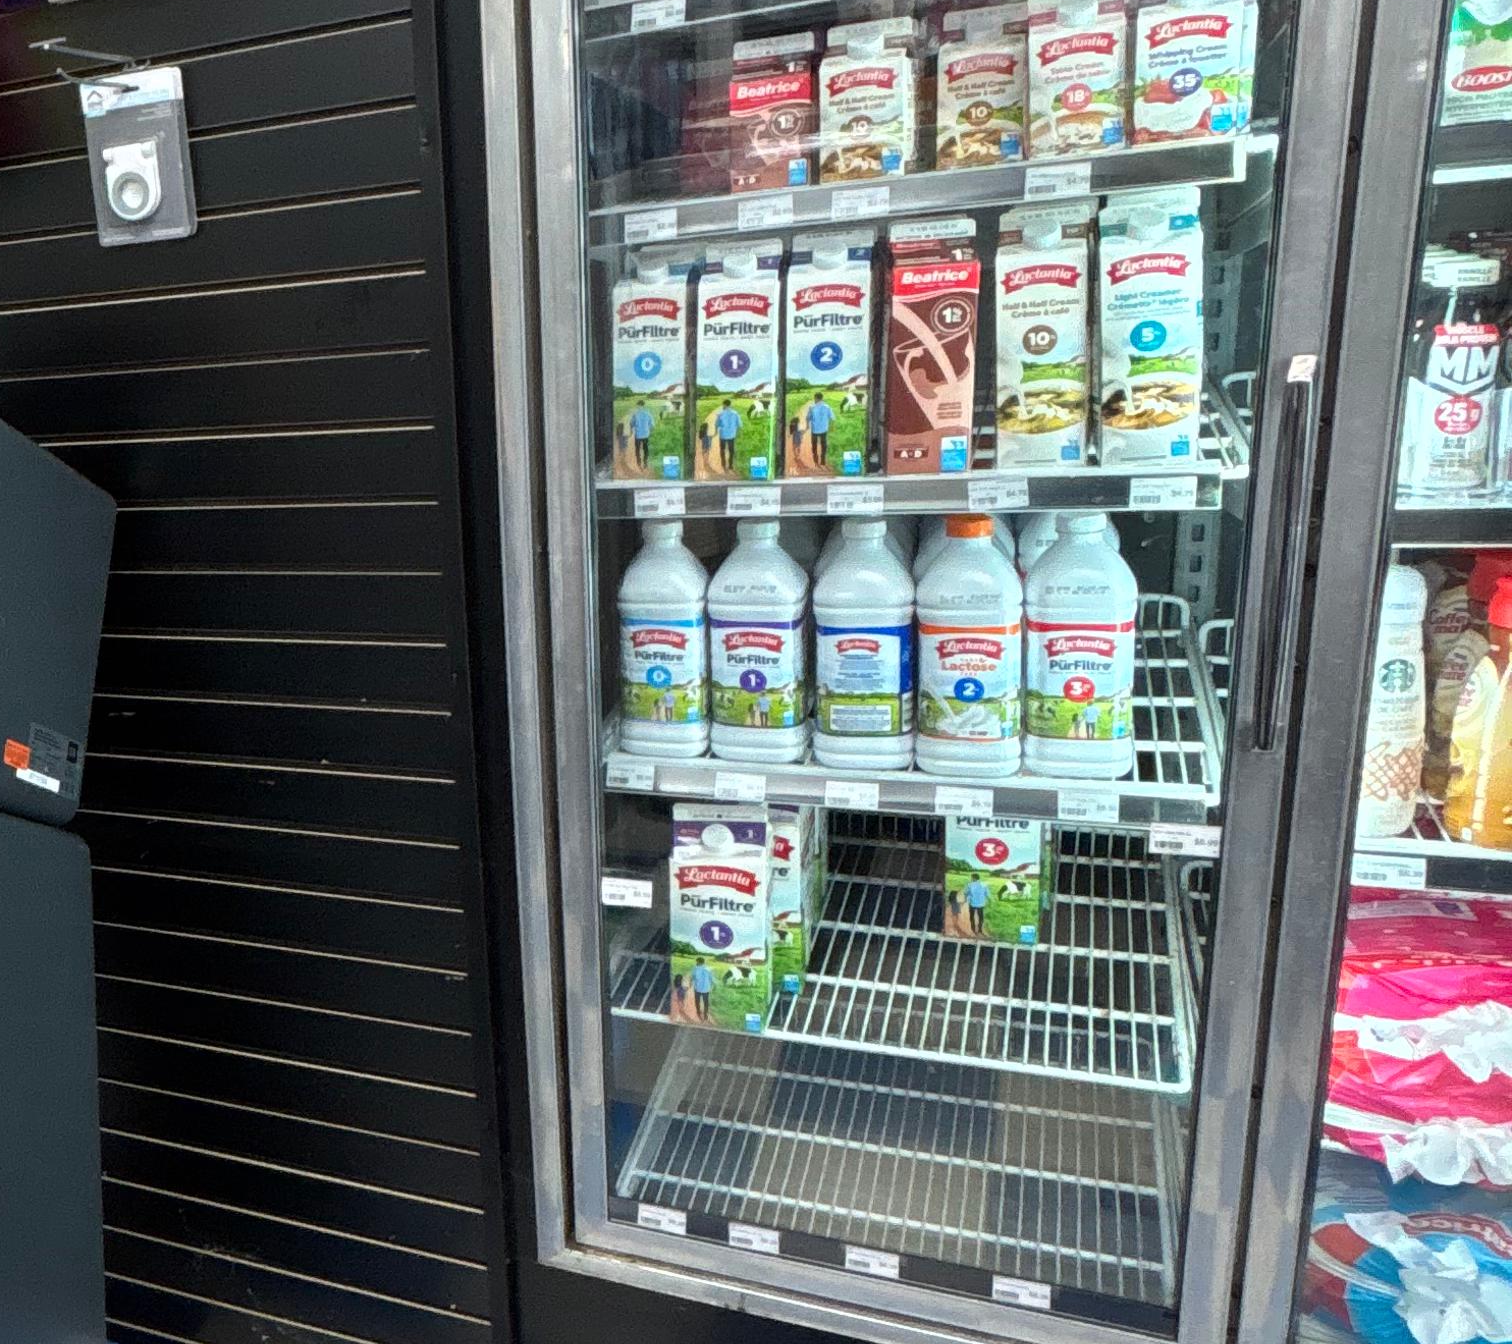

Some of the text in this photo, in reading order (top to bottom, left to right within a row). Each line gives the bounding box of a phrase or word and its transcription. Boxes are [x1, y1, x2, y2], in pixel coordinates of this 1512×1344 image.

[1153, 18, 1224, 43] Lactantia
[1044, 36, 1110, 59] Lactantia
[833, 70, 890, 89] Lactantia
[736, 81, 801, 100] Beatrice
[1115, 257, 1185, 276] Lactantia
[901, 269, 968, 285] Beatrice
[1010, 268, 1074, 286] Lactantia
[711, 295, 766, 315] Lactantia
[799, 287, 858, 307] Lactantia
[624, 299, 675, 317] Lactantia
[1438, 402, 1468, 422] 25
[730, 634, 779, 646] Lactantia
[942, 639, 998, 653] Lactantia
[1052, 638, 1111, 651] Lactantia
[941, 660, 997, 672] Lactose
[683, 867, 752, 887] Lactantia
